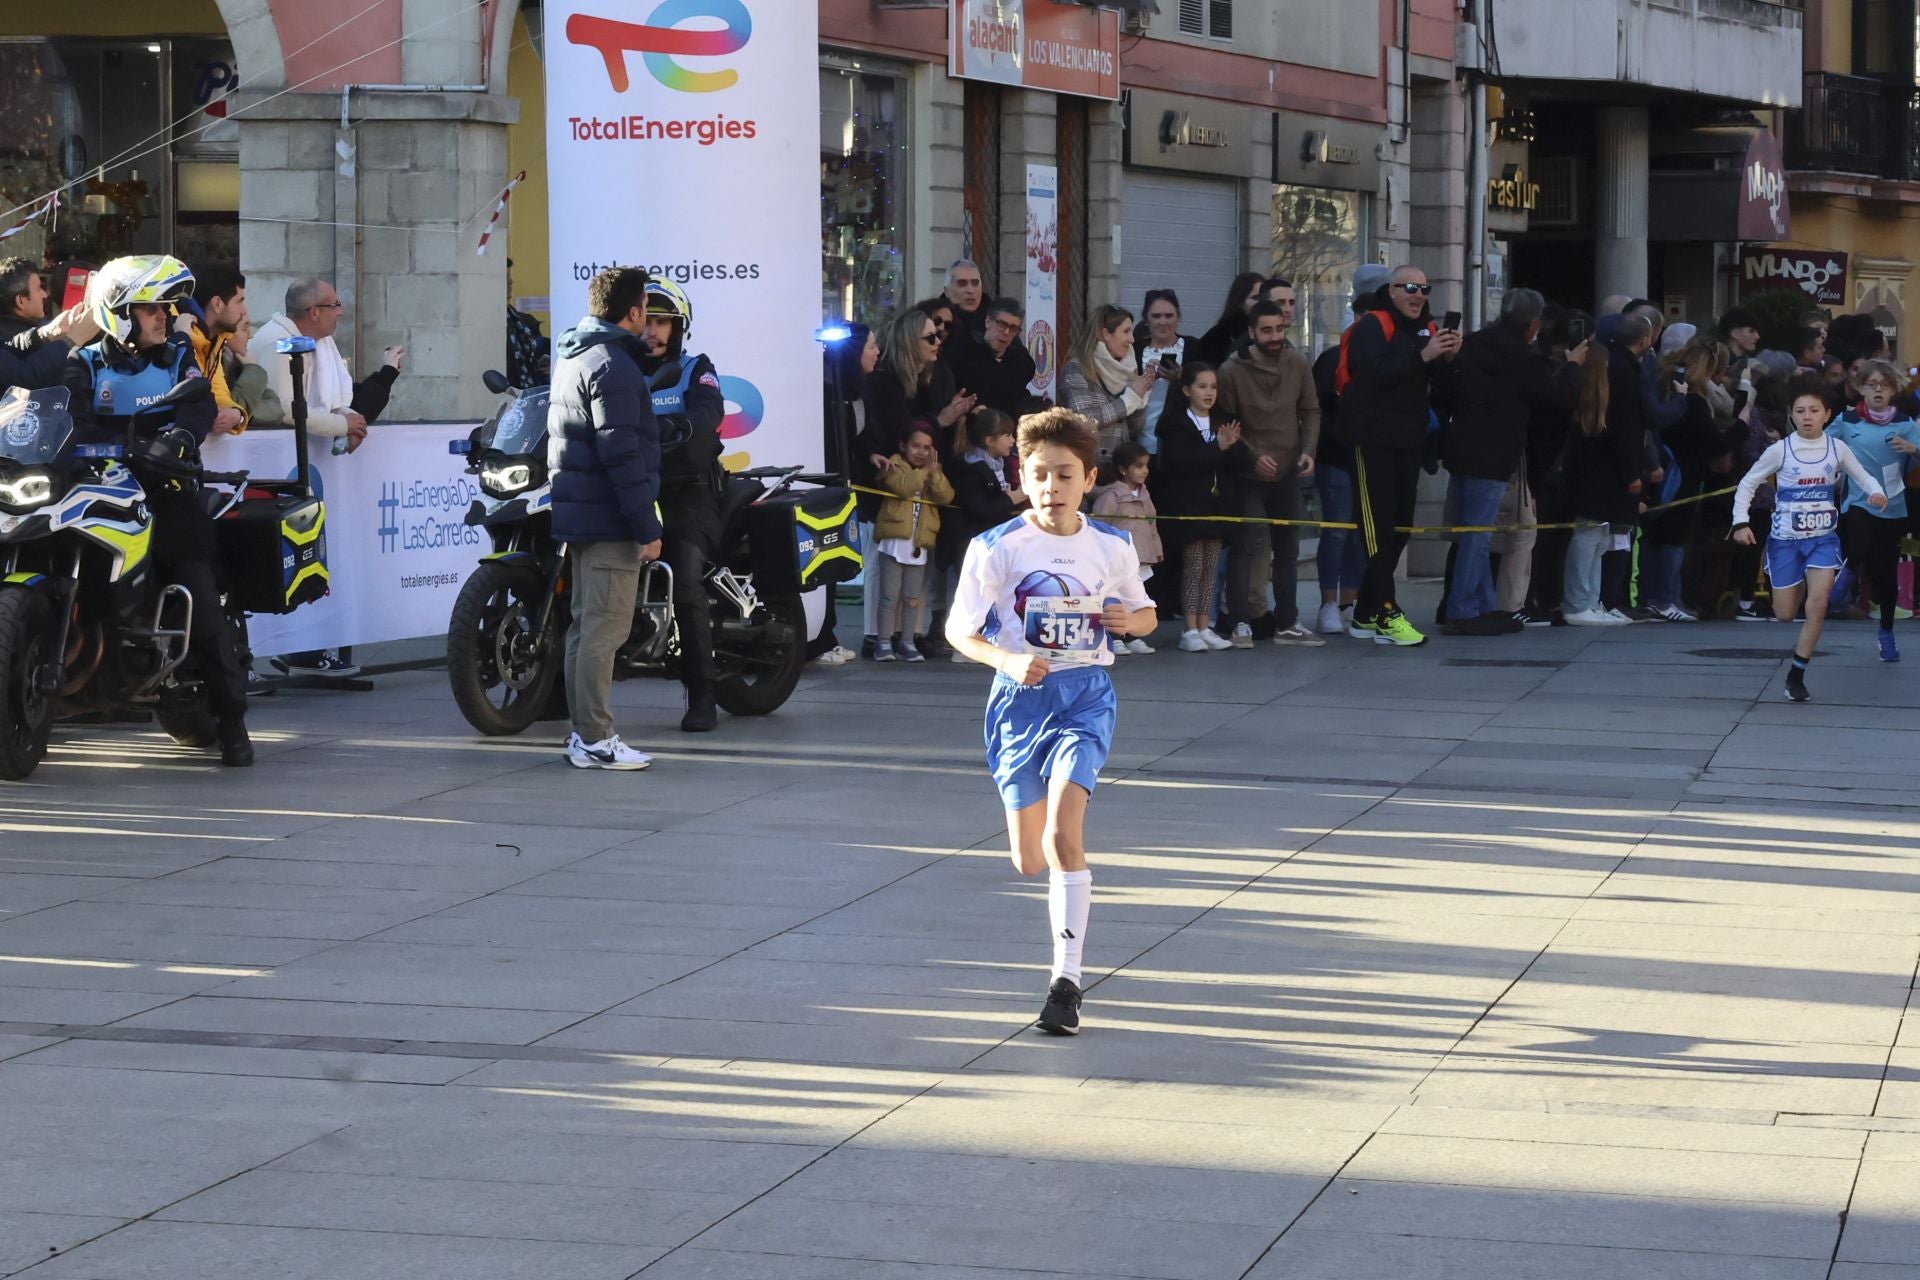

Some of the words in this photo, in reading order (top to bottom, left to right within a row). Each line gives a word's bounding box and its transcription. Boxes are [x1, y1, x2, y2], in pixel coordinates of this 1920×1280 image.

[1028, 38, 1047, 65] LOS
[1049, 42, 1112, 76] VALENCIANOS
[568, 113, 756, 146] TotalEnergies
[573, 260, 760, 284] totergies.es
[402, 516, 480, 550] LasCarreras
[1797, 512, 1832, 530] 3608
[799, 539, 814, 553] 092
[823, 532, 839, 545] GS
[283, 554, 295, 569] 092
[302, 547, 314, 561] GS
[400, 572, 459, 589] totalenergies.es
[1039, 618, 1095, 645] 3134
